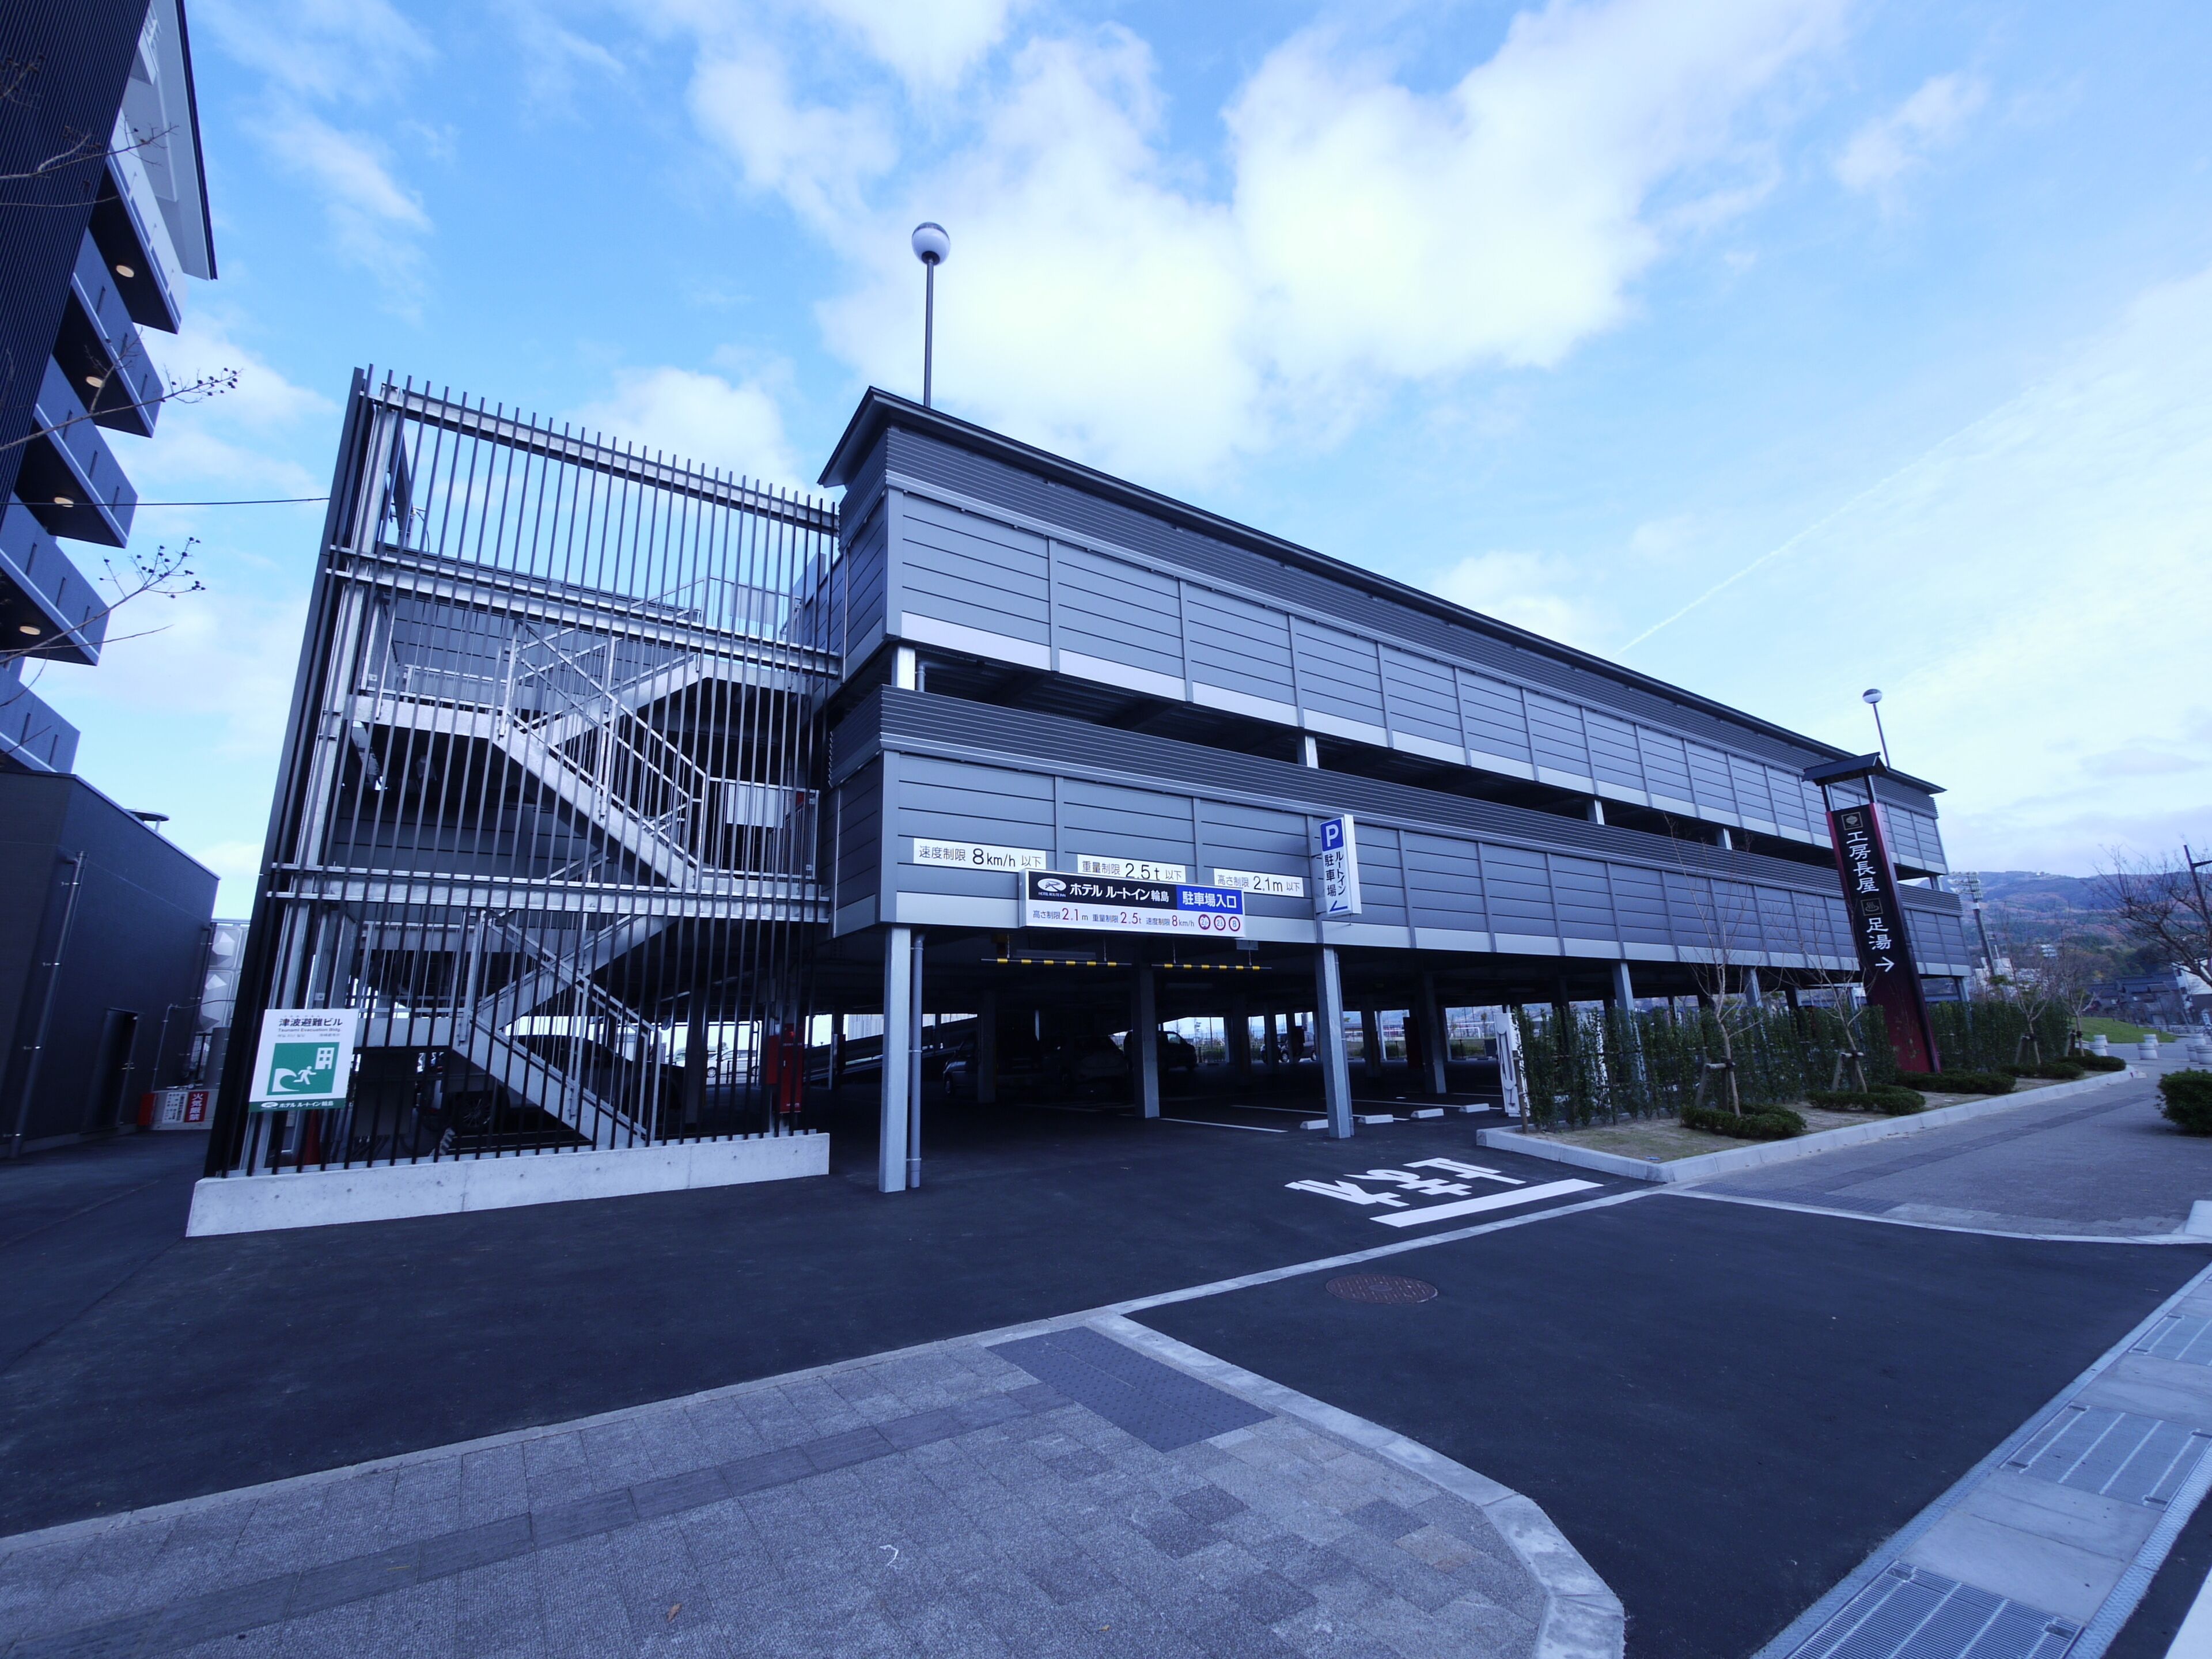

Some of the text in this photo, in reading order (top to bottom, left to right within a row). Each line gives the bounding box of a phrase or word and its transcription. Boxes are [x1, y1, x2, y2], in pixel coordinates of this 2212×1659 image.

[1325, 824, 1339, 847] P
[919, 845, 966, 862] 速度制限
[1021, 855, 1042, 867] 以下
[1846, 831, 1879, 893] 工房長屋
[1082, 860, 1120, 876] 重量制限
[1165, 869, 1183, 881] 以下
[1325, 854, 1336, 897] 駐車場
[1335, 851, 1346, 896] ルートイン
[1070, 883, 1103, 897] ホテル
[1217, 874, 1249, 888] 高さ制限
[1286, 881, 1300, 892] 以下
[1182, 891, 1237, 908] 駐車場入口
[1033, 910, 1060, 920] 高さ制限
[1092, 914, 1119, 923] 重量制限
[1866, 917, 1892, 950] 足湯
[279, 1018, 343, 1027] 津波避難ビル
